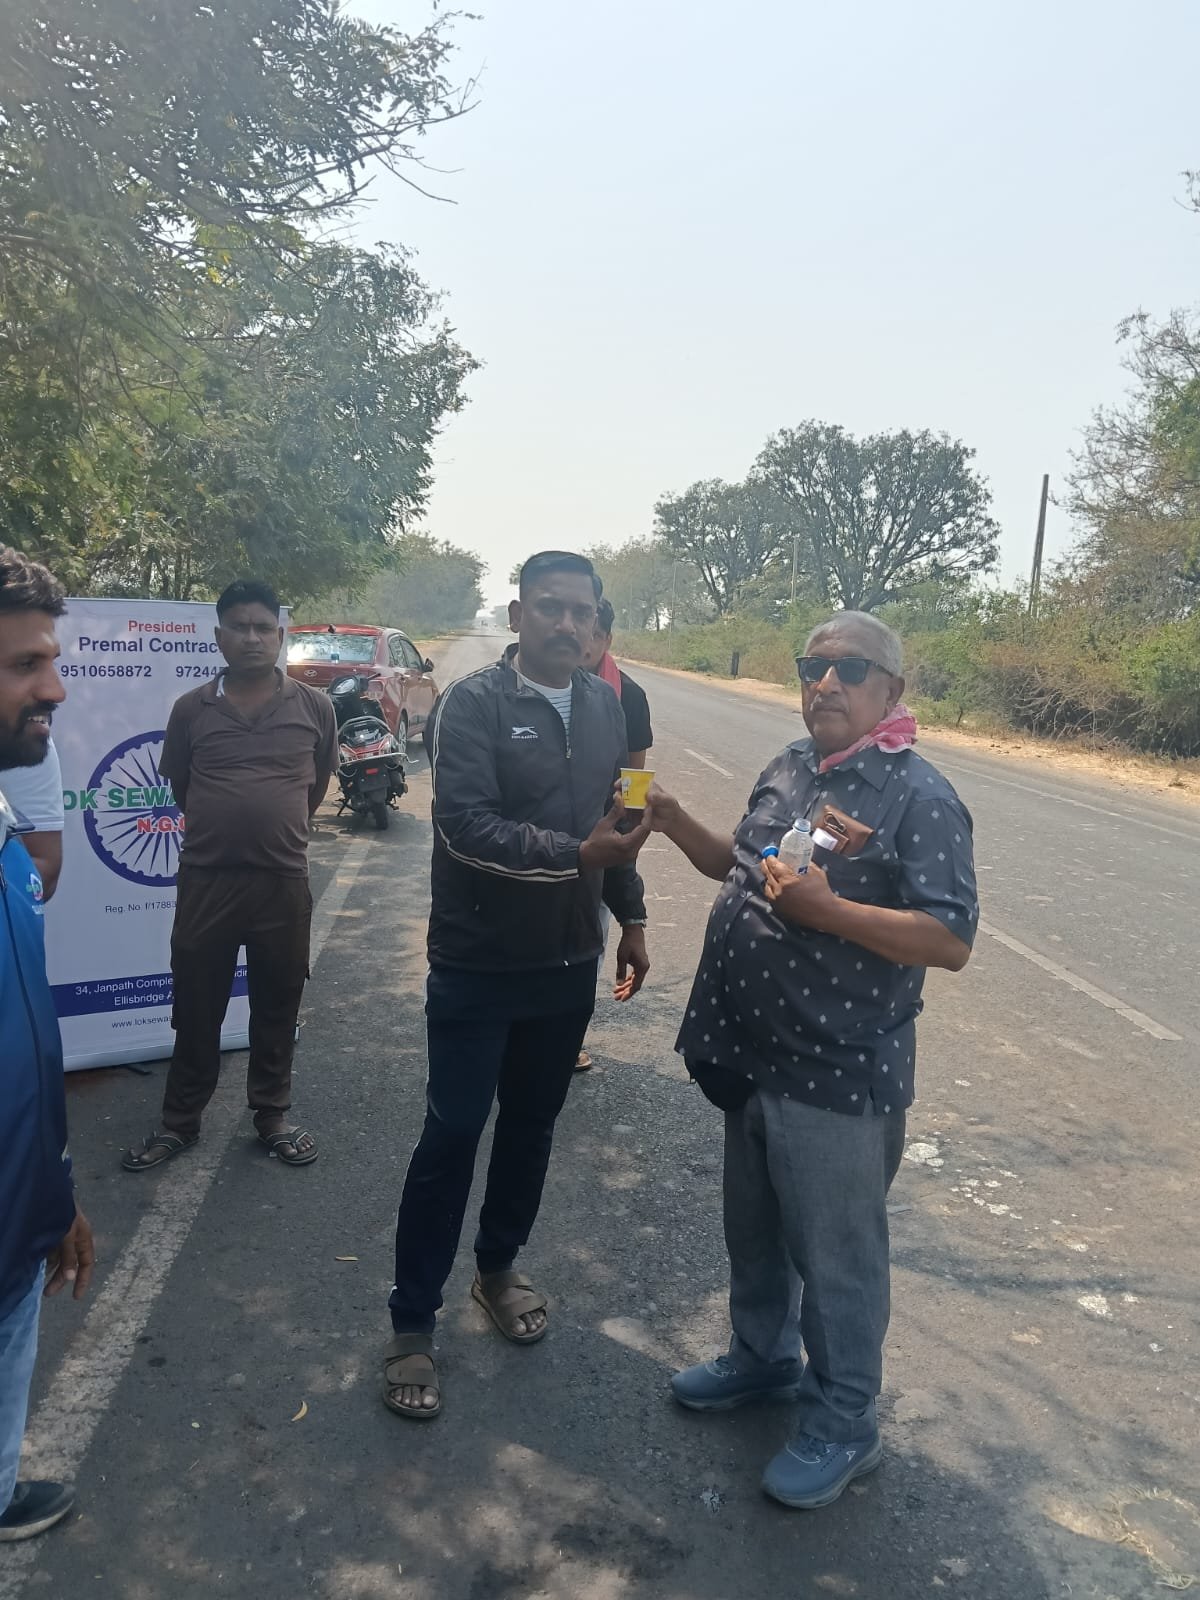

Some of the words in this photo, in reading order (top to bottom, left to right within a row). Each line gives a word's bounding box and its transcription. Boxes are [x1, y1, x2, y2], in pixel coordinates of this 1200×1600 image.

[128, 620, 196, 633] President
[79, 637, 143, 653] Premal
[61, 665, 152, 678] 9510658872
[75, 986, 91, 996] 34,
[94, 981, 133, 993] Janpath
[136, 977, 173, 989] Comple
[114, 993, 164, 1006] Ellisbridge
